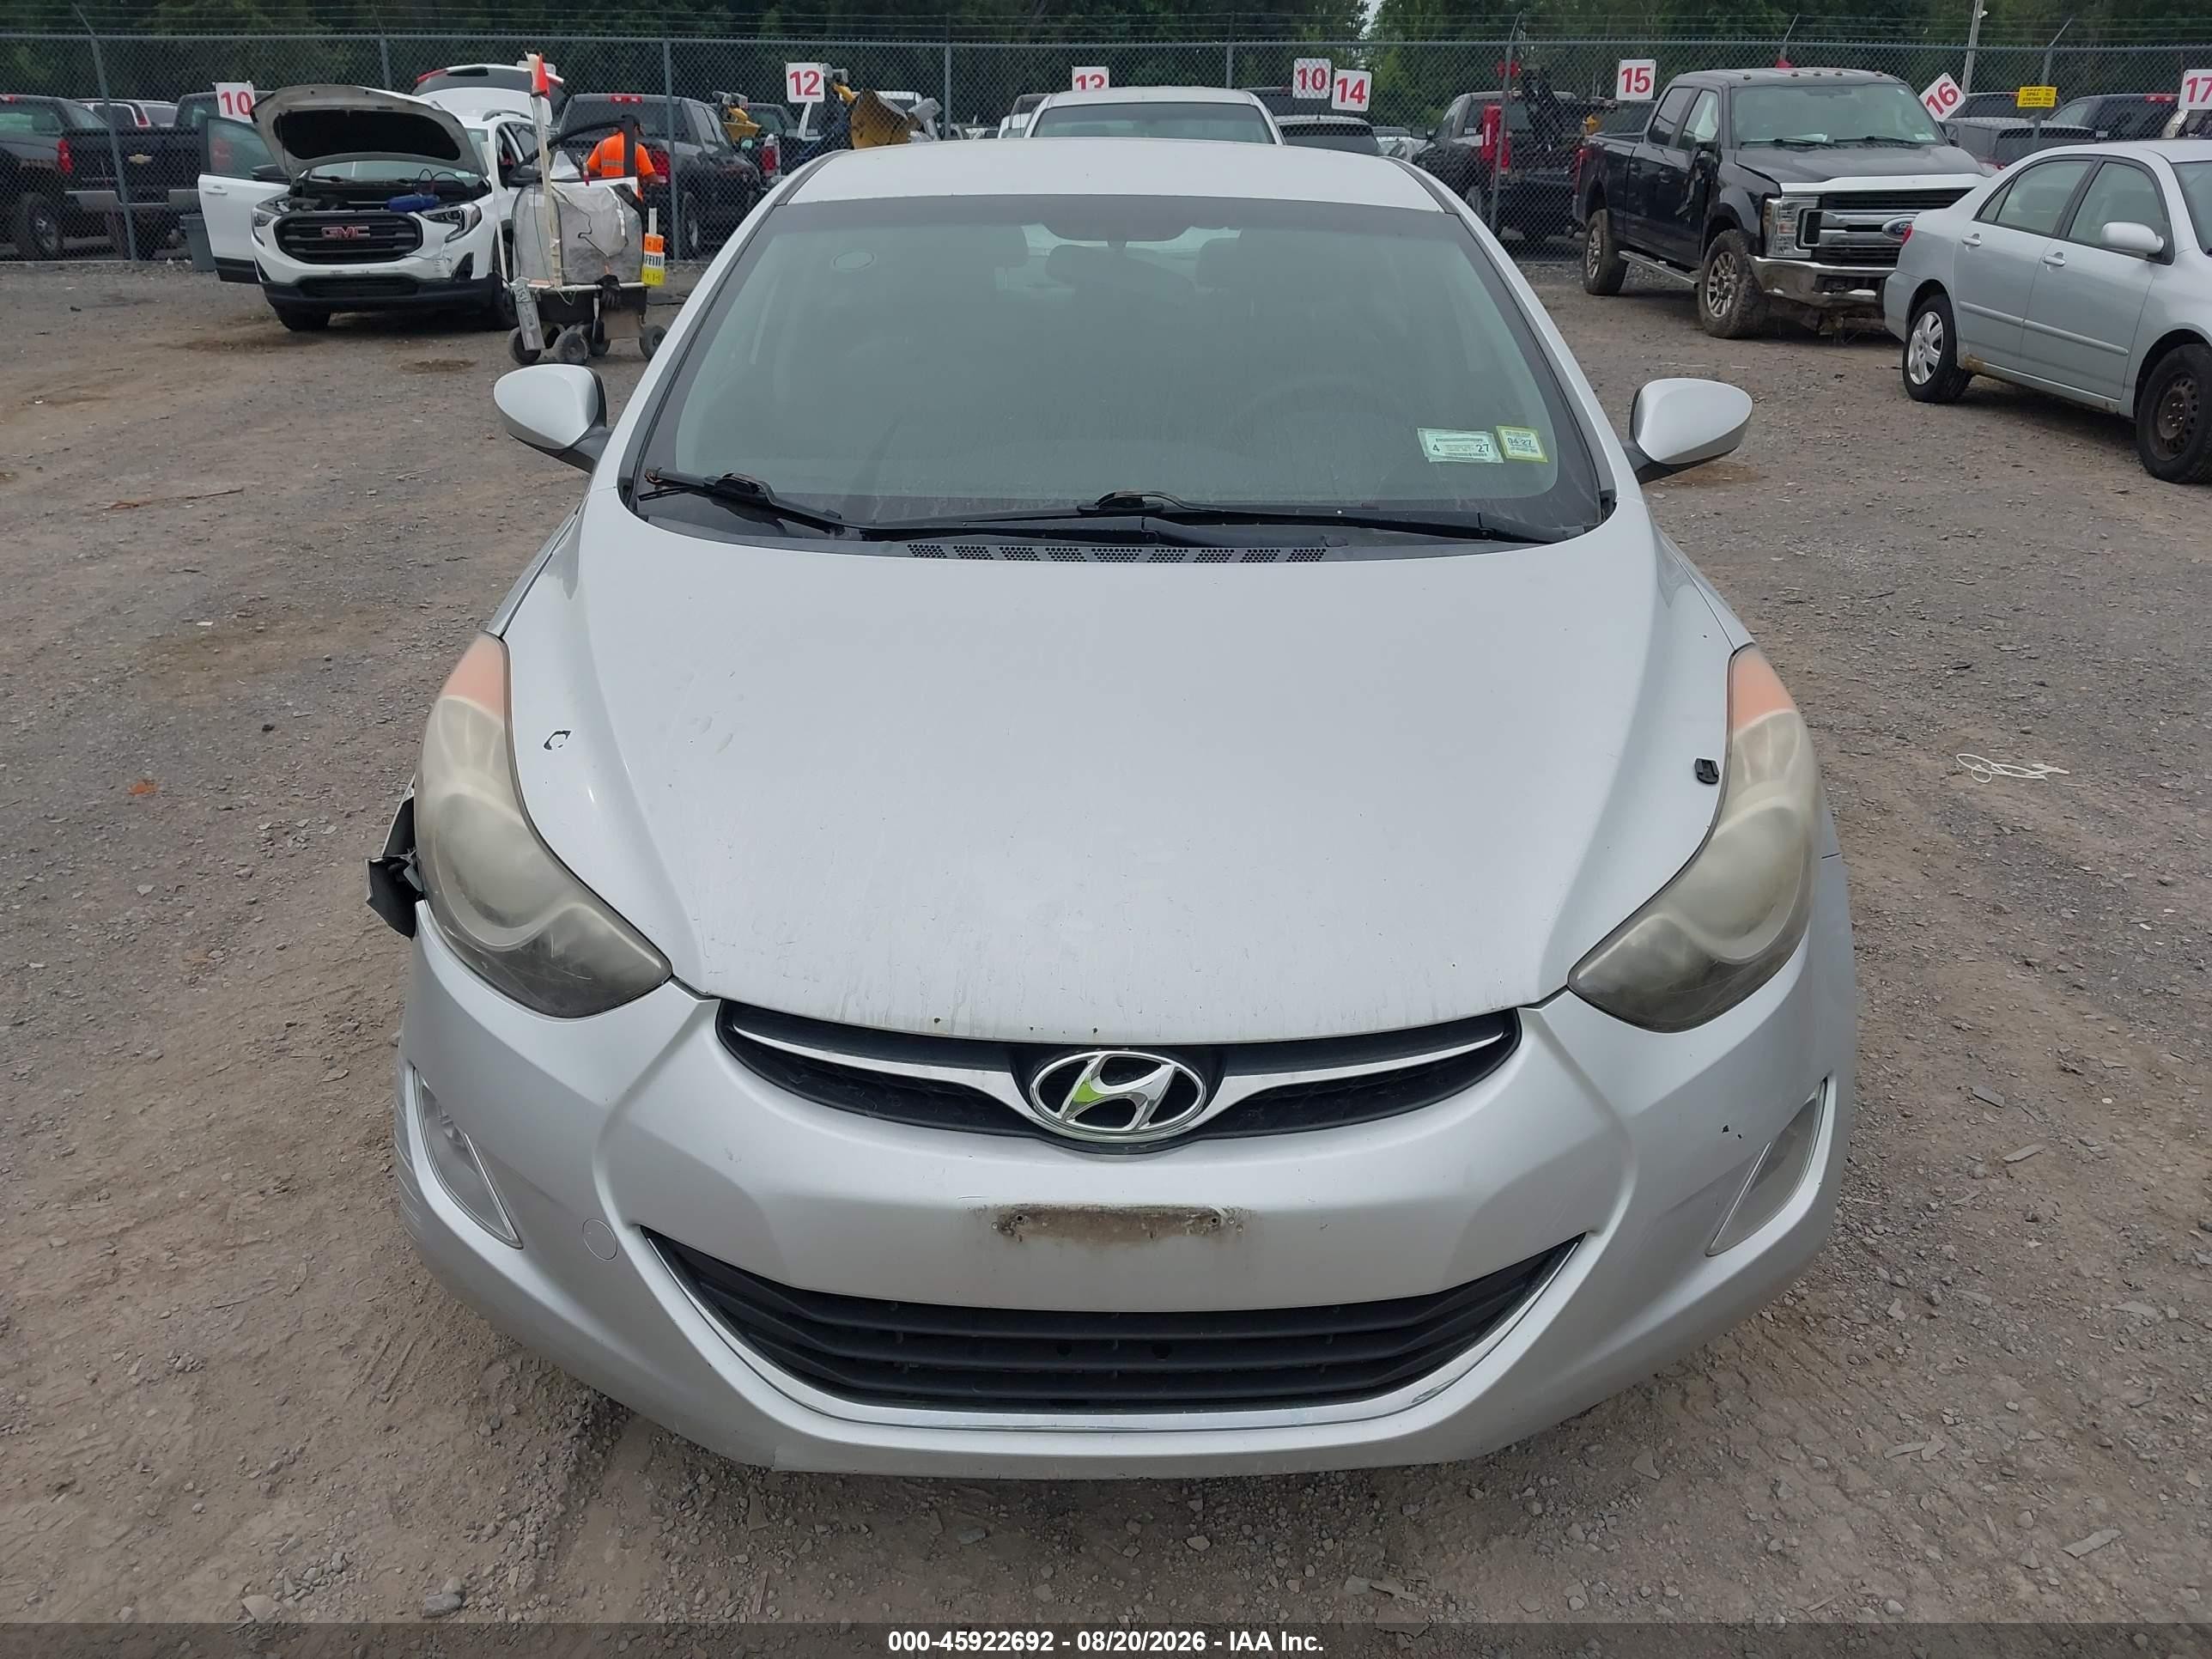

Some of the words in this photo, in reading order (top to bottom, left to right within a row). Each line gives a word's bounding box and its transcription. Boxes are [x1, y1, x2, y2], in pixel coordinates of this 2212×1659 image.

[789, 70, 821, 95] 12
[1297, 67, 1327, 91] 10
[1336, 77, 1366, 104] 14
[1621, 68, 1650, 94] 15
[2185, 76, 2212, 102] 17
[220, 90, 252, 116] 10
[1925, 82, 1959, 115] 16
[321, 226, 371, 240] GMC
[1432, 443, 1441, 453] 4
[1475, 443, 1489, 453] 27
